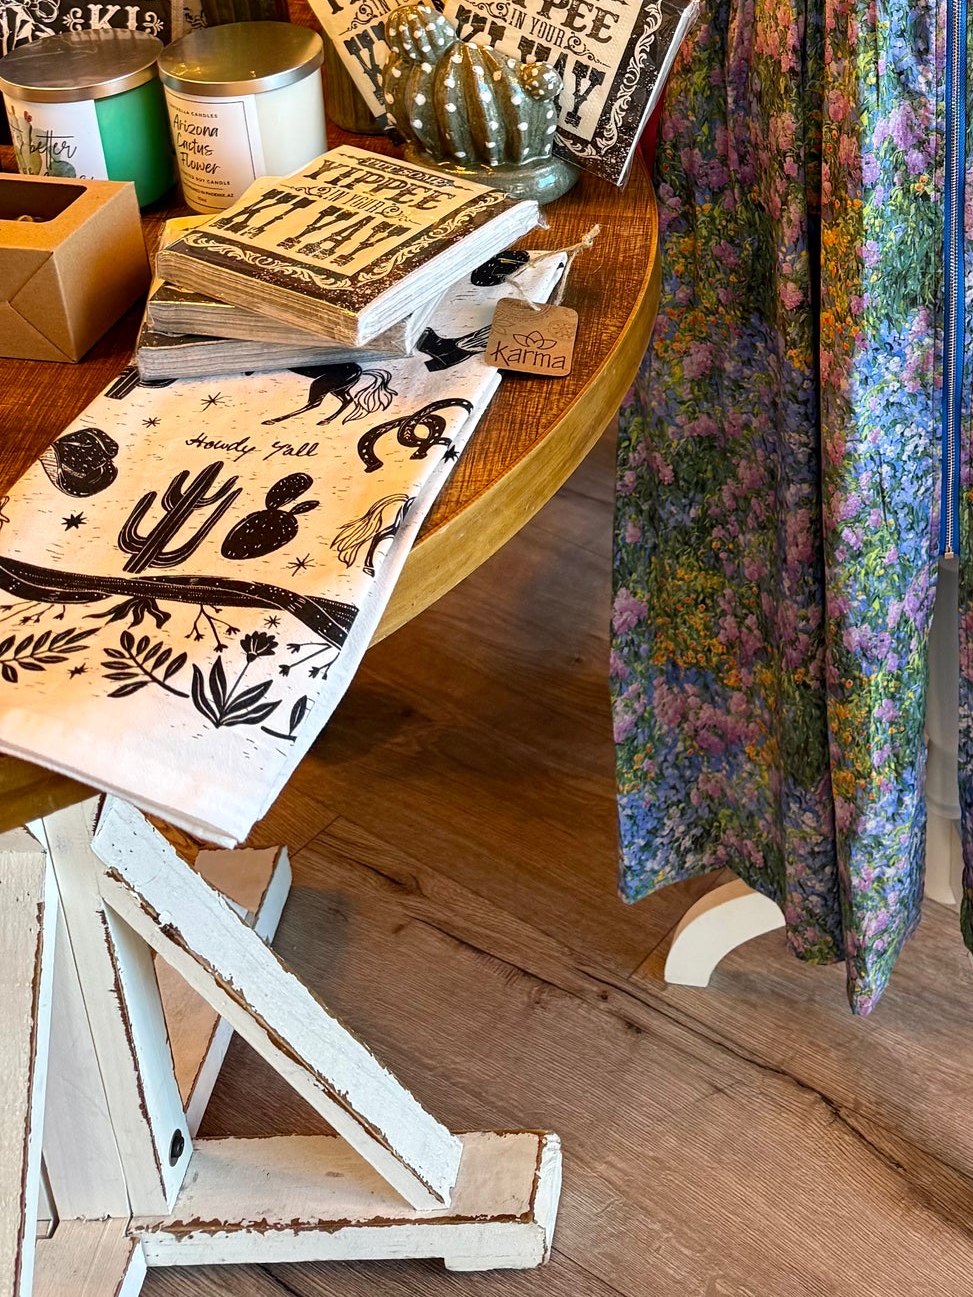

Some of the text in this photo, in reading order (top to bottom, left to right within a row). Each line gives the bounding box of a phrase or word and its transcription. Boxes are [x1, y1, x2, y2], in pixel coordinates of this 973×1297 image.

[508, 7, 566, 49] IN YOUR
[173, 113, 220, 138] Arizona
[30, 129, 77, 170] better
[176, 132, 214, 156] Cactus
[180, 151, 222, 175] Flower
[302, 159, 456, 212] YIPPEE
[326, 189, 384, 214] IN YOUR
[208, 188, 412, 267] KI YAY
[185, 432, 259, 462] Howdy
